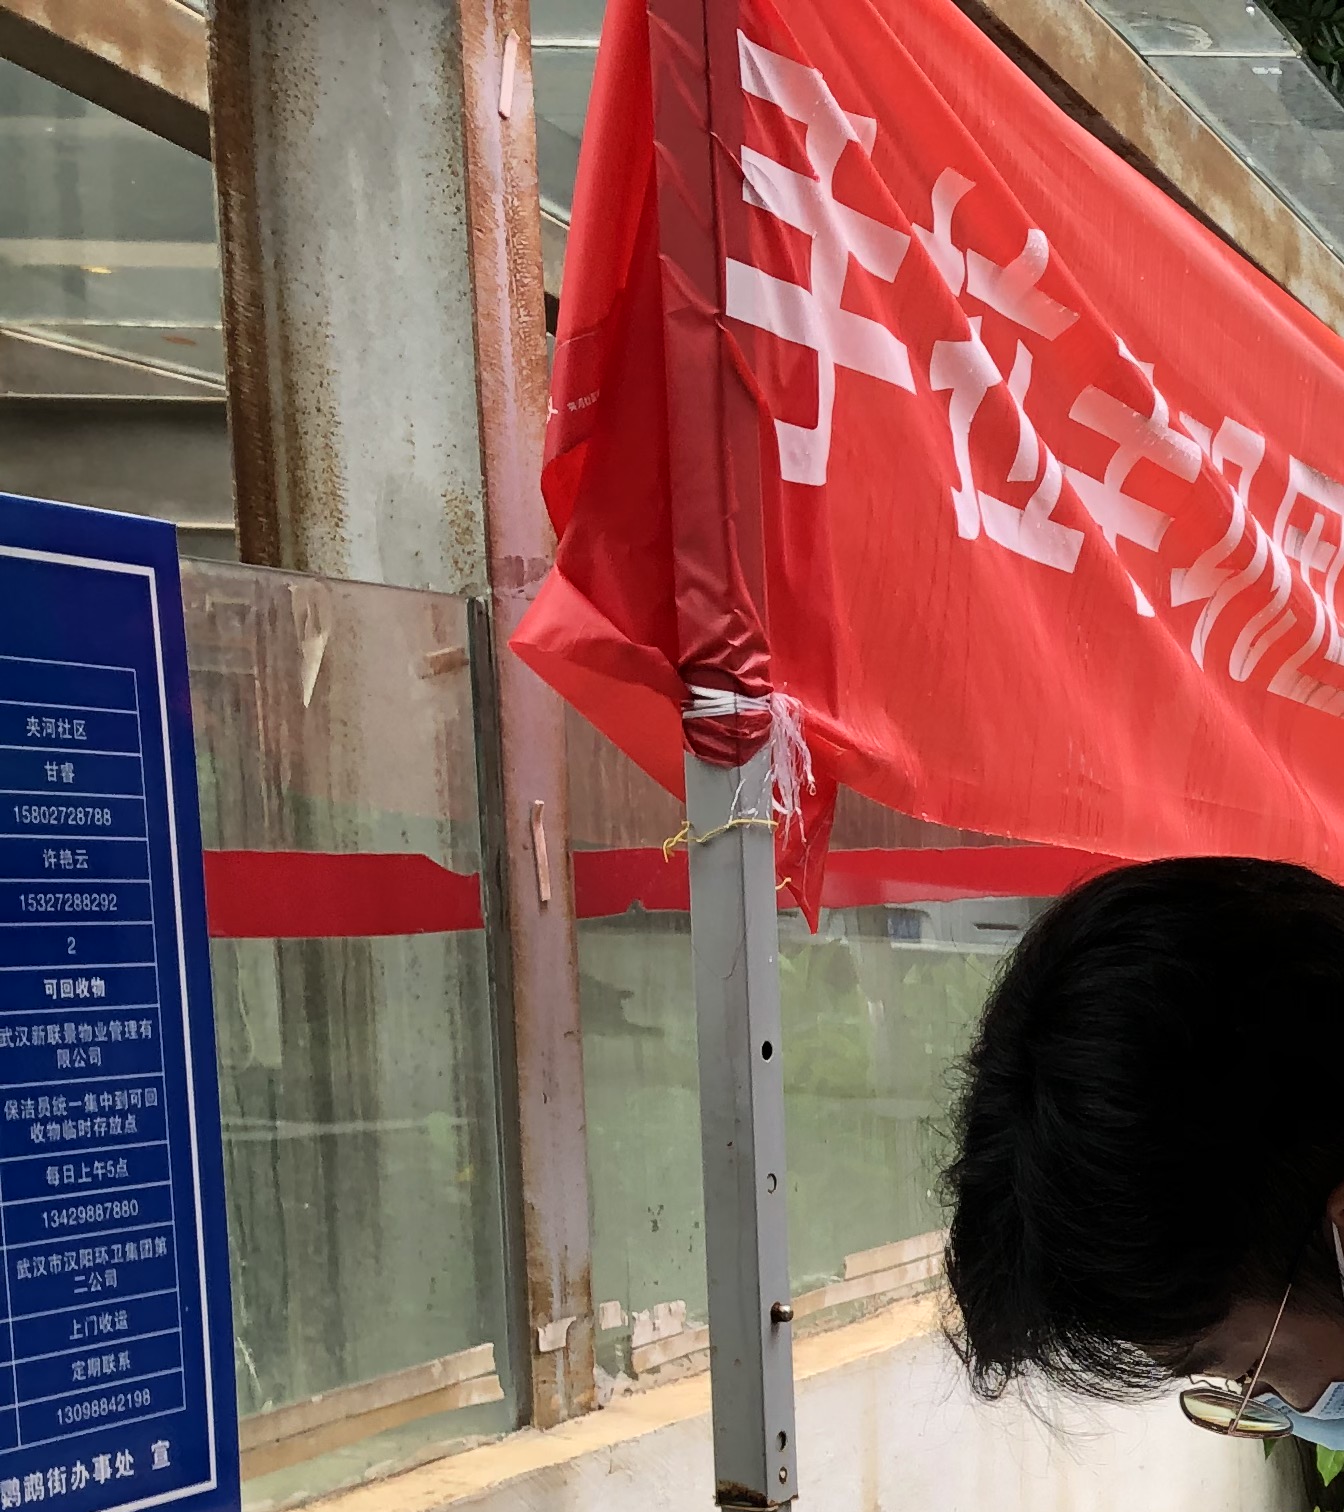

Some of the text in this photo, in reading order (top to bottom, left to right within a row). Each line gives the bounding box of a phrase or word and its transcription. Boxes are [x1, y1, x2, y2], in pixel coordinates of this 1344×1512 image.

[26, 715, 87, 740] 夹河社区
[13, 805, 112, 826] 15802728788
[19, 893, 118, 912] 15327288292
[67, 936, 77, 955] 2
[43, 976, 106, 1000] 可回收物
[56, 1046, 102, 1070] 限公司
[4, 1087, 158, 1121] 保洁员统一集中到可回
[30, 1113, 138, 1144] 收物临时存放点
[46, 1157, 130, 1187] 每日上午5点
[42, 1199, 139, 1229] 13429887880
[16, 1236, 168, 1280] 武汉市汉阳环卫集团第
[73, 1268, 118, 1294] 二公司
[71, 1350, 131, 1382] 定期联系
[56, 1388, 151, 1426] 13098842198
[0, 1439, 171, 1511] 鹦鹉街办事处 宣
